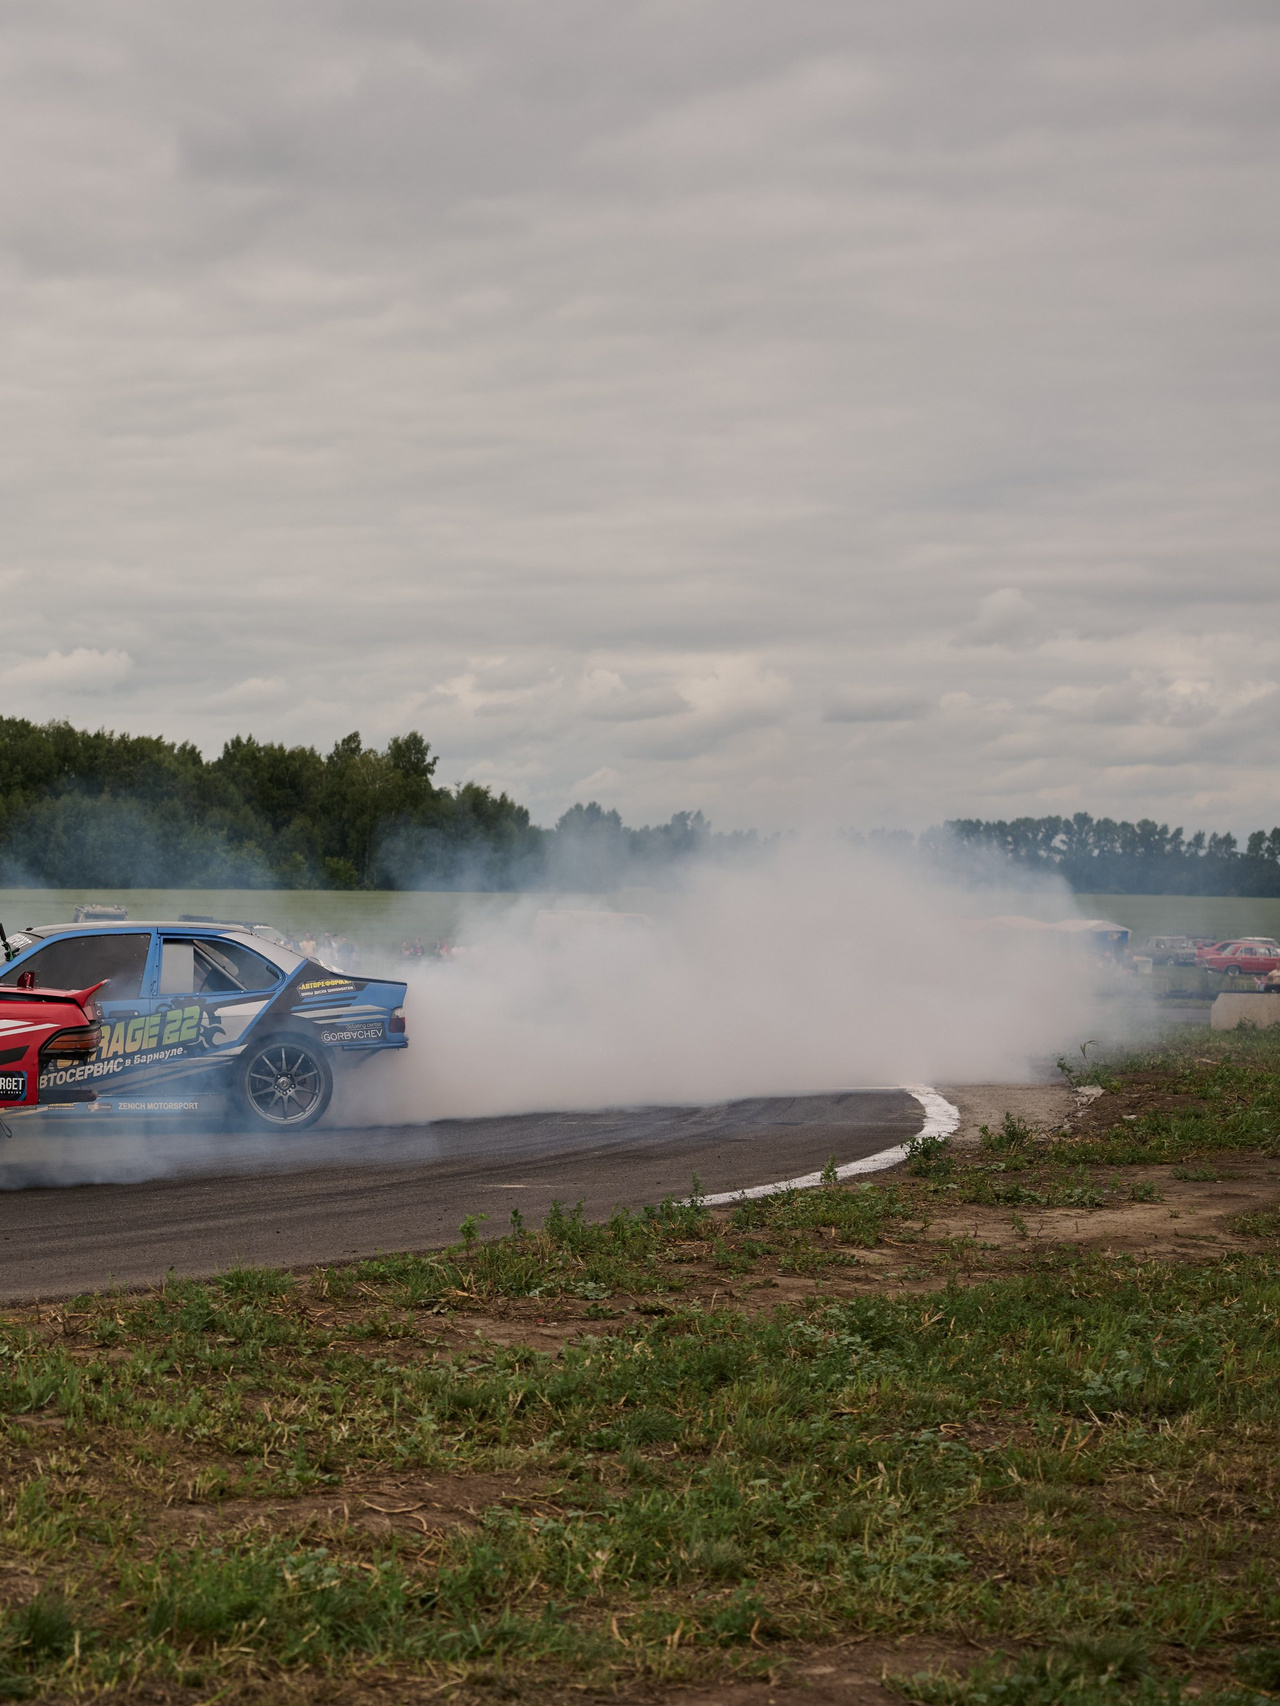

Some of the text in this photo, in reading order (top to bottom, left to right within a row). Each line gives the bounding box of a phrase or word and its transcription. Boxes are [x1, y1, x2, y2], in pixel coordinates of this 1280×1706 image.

[161, 1005, 201, 1046] 22
[39, 1057, 124, 1089] ВТОСЕРВИС
[133, 1046, 184, 1065] Барнауле
[118, 1102, 146, 1110] ZENICH
[147, 1102, 199, 1110] MOTORSPORT
